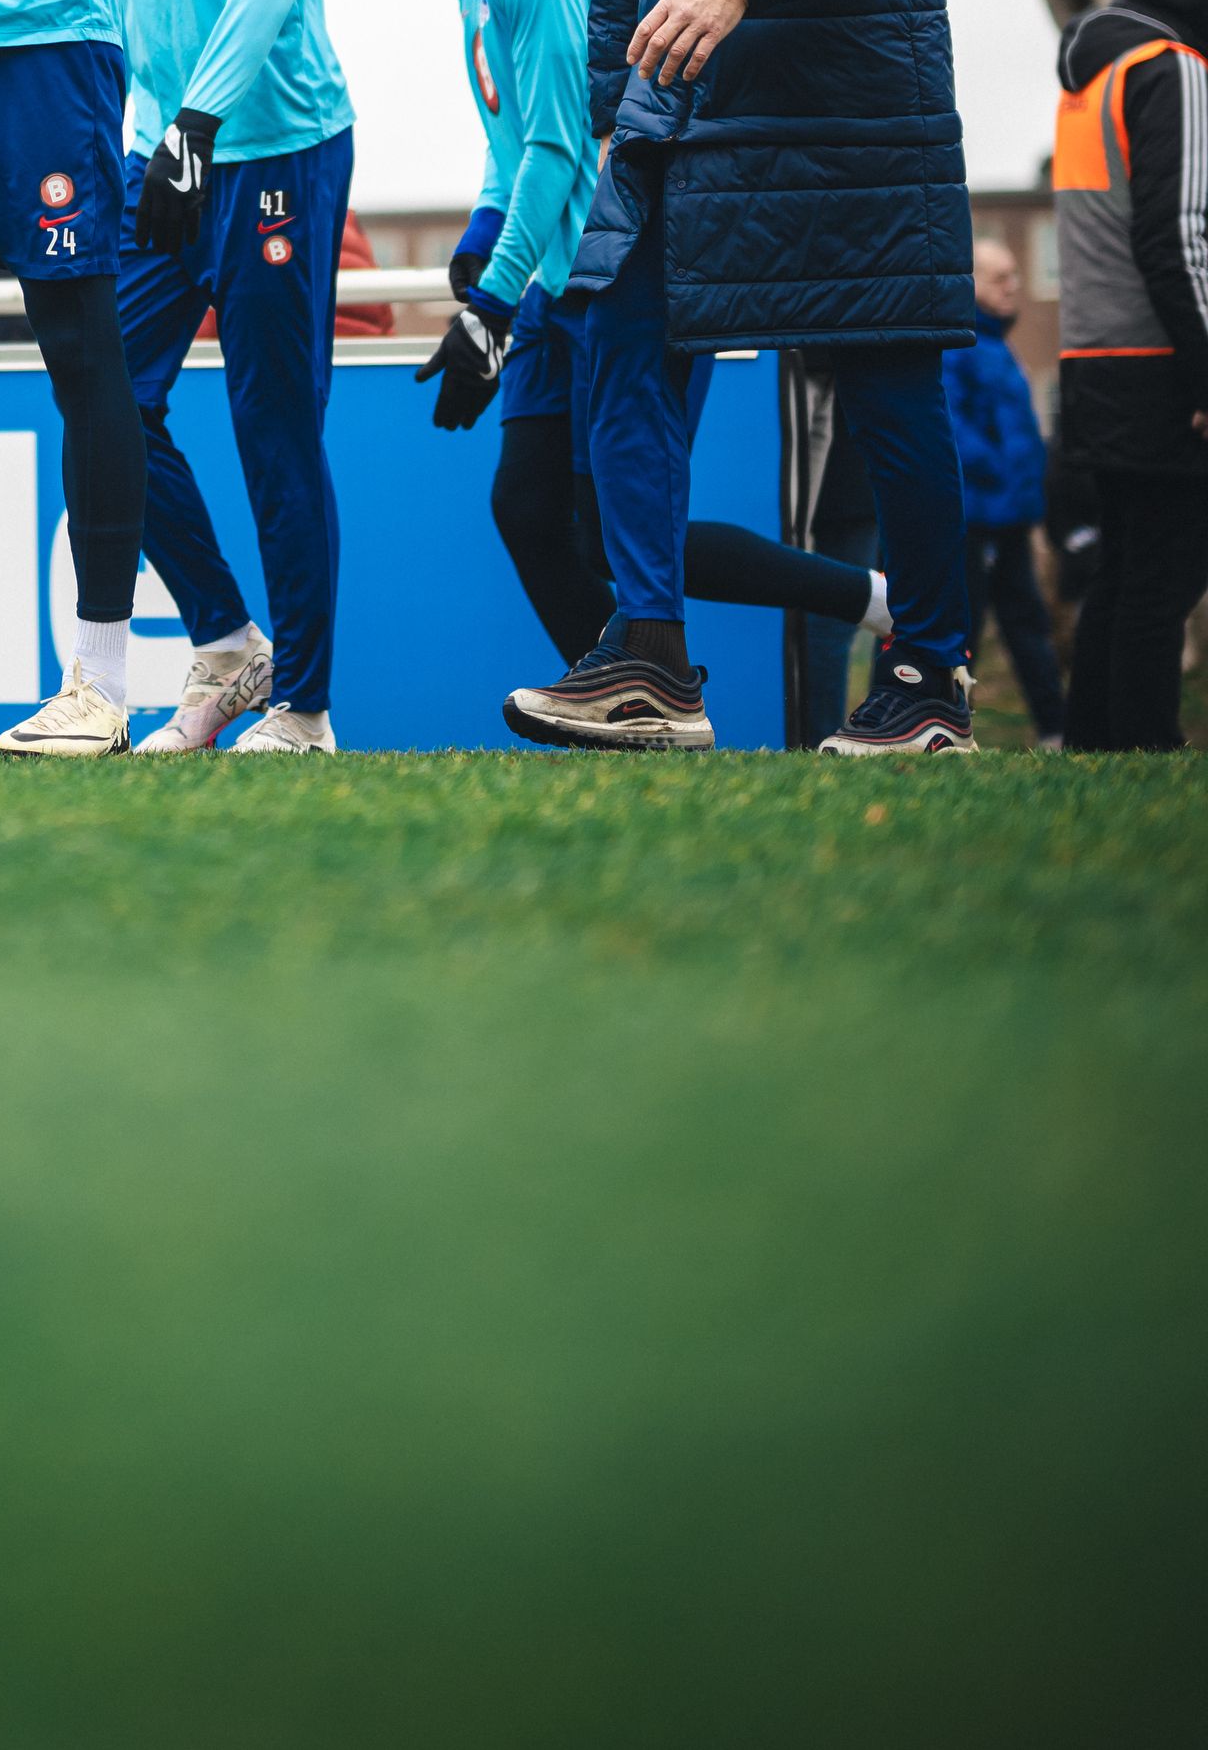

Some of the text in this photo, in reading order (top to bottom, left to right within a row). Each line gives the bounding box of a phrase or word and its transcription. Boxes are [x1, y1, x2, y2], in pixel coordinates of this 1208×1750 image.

[47, 179, 67, 203] B
[259, 190, 286, 216] 41
[45, 227, 76, 256] 24
[268, 239, 287, 262] B
